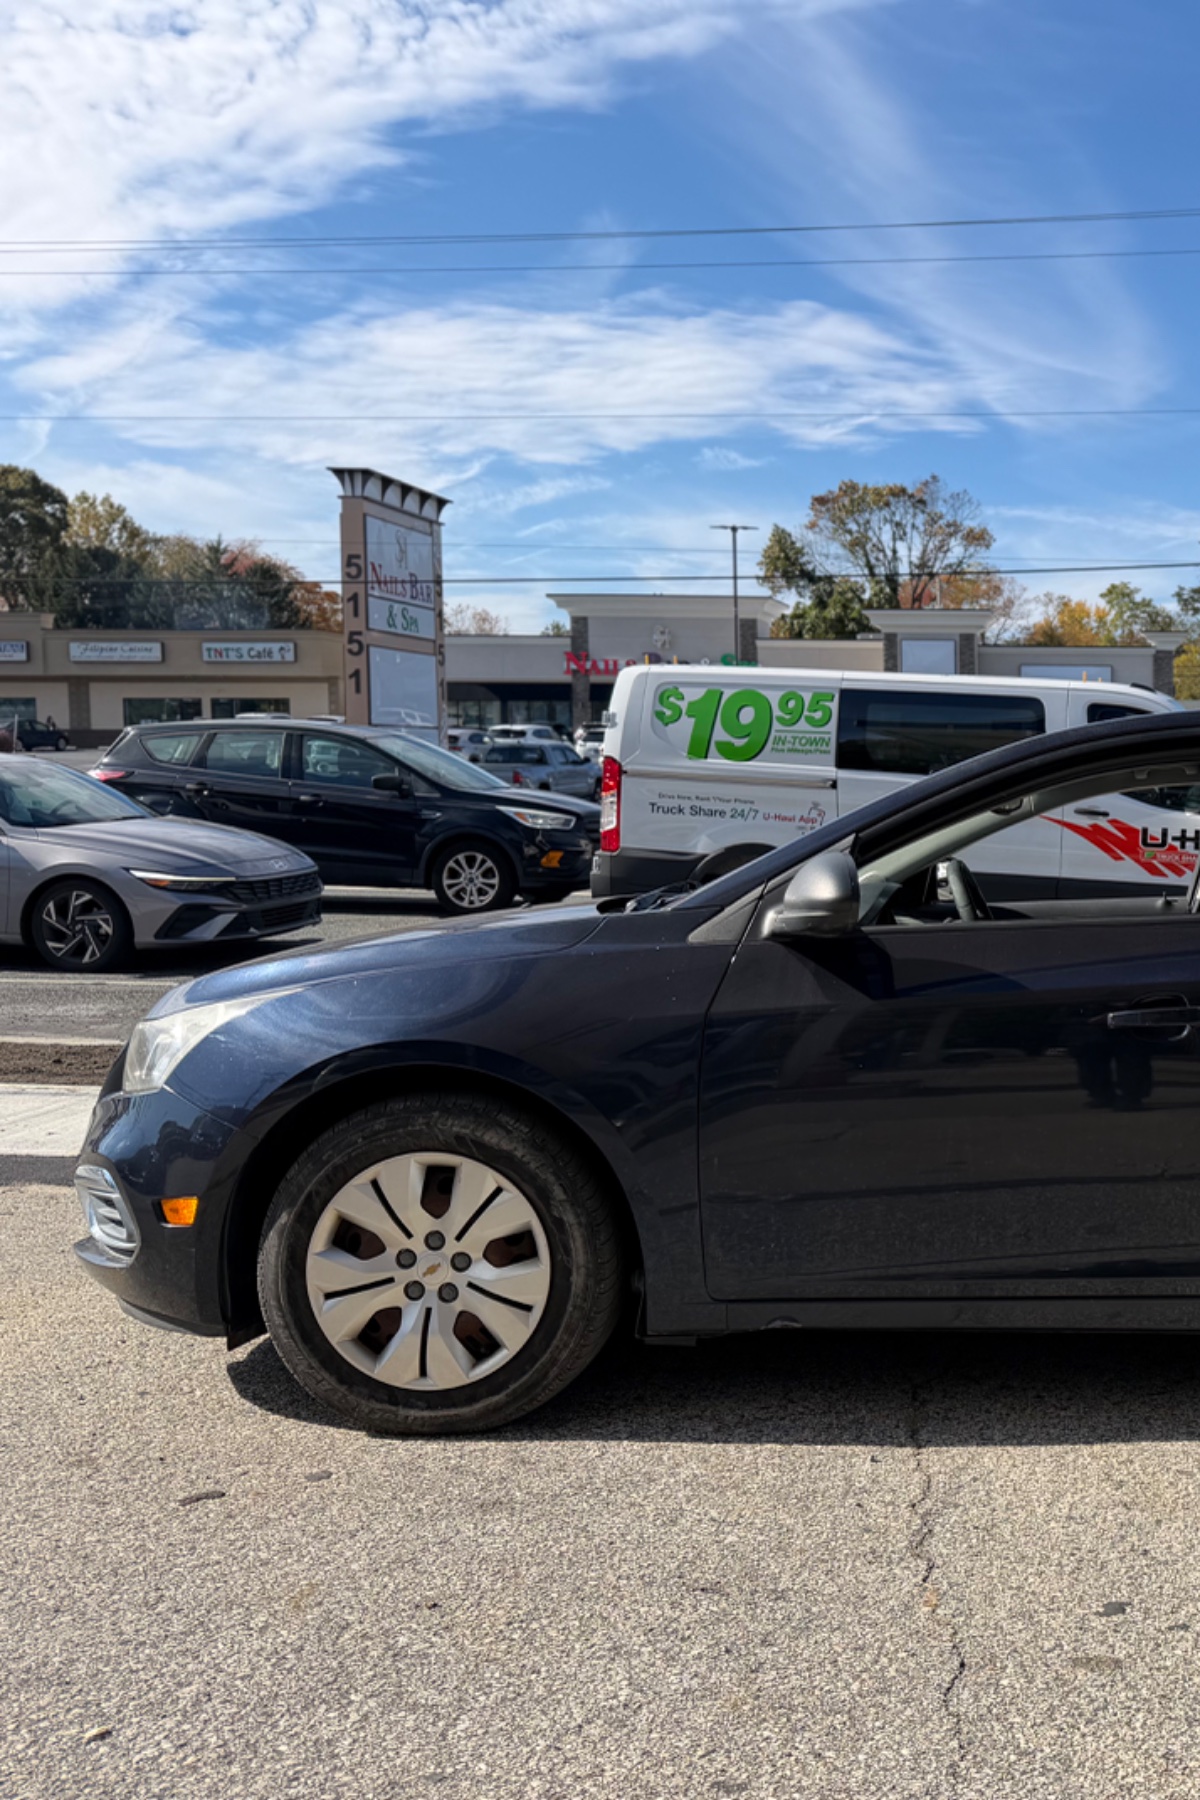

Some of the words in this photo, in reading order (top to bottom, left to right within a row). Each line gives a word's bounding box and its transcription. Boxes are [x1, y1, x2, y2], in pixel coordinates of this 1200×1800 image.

[386, 604, 397, 629] &
[772, 735, 831, 748] IN-TOWN
[649, 802, 686, 816] Truck
[689, 804, 727, 819] Share
[729, 807, 759, 822] 24/7
[762, 812, 796, 823] U-Haul
[798, 814, 818, 825] App
[1140, 827, 1200, 851] U-H
